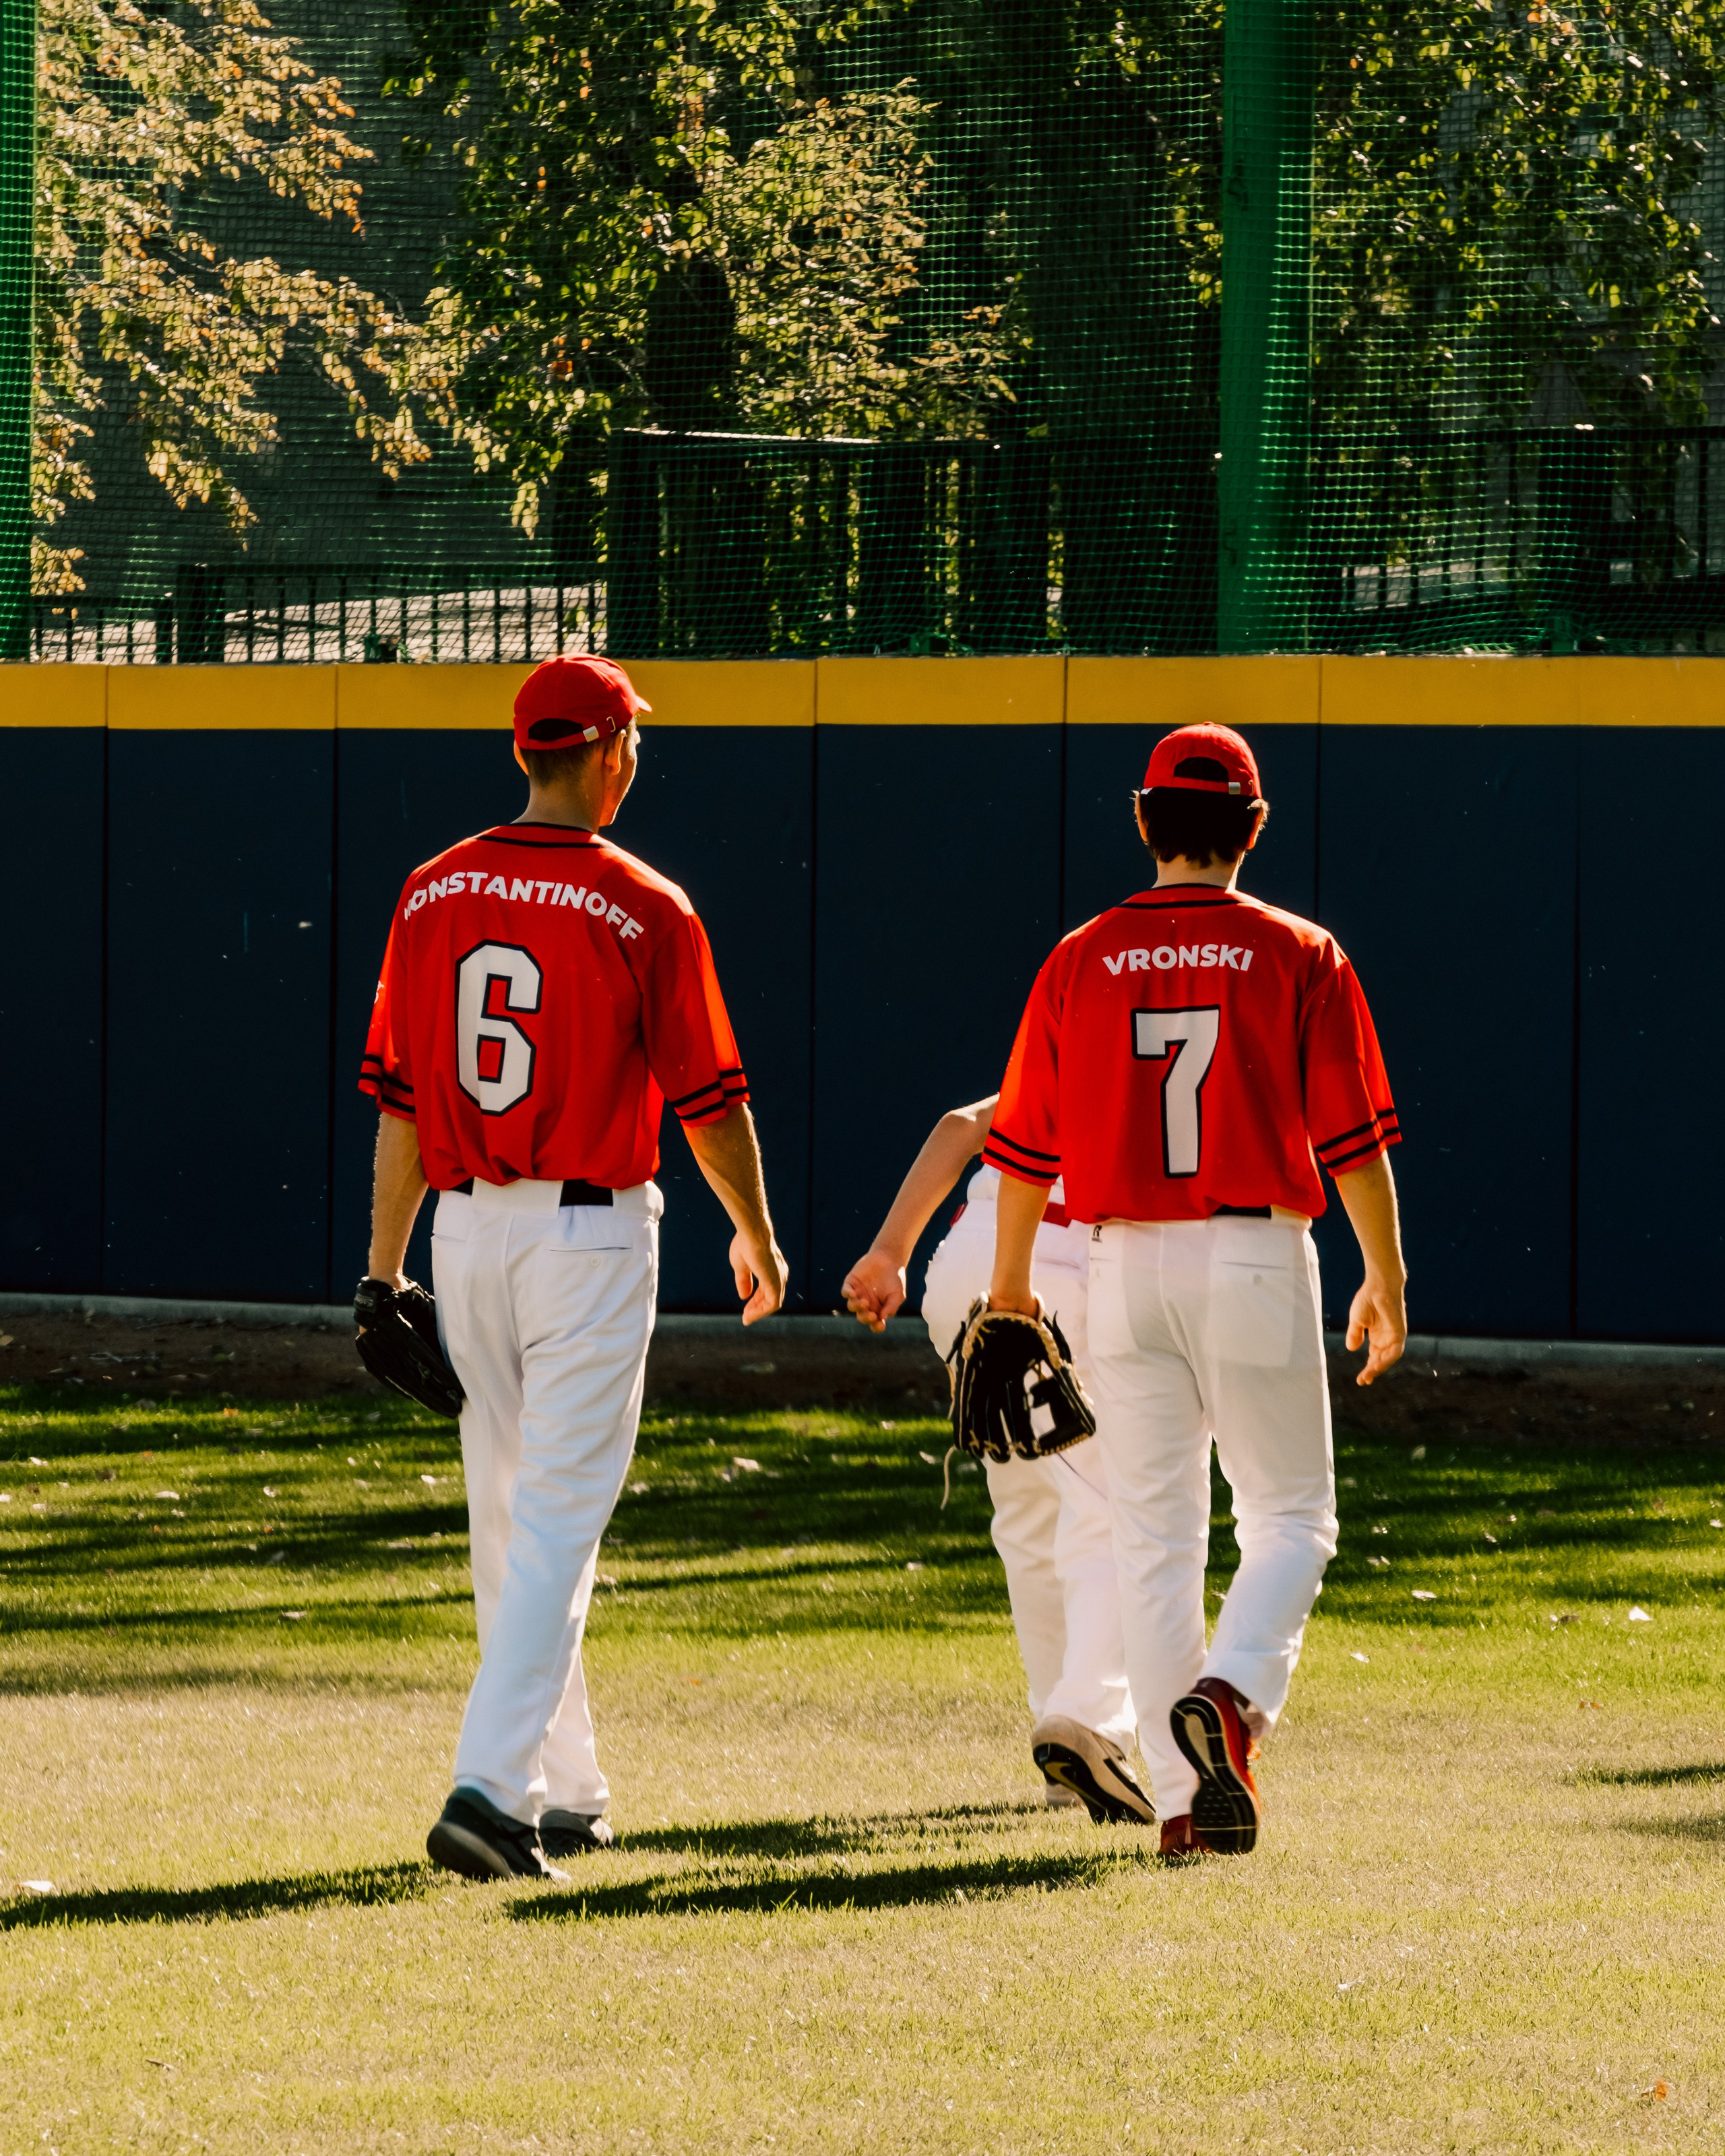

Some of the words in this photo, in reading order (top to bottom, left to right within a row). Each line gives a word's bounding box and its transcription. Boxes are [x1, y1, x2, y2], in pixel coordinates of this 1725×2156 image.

[455, 939, 544, 1117] 6
[1102, 944, 1253, 976] VRONSKI
[1130, 1004, 1221, 1179] 7
